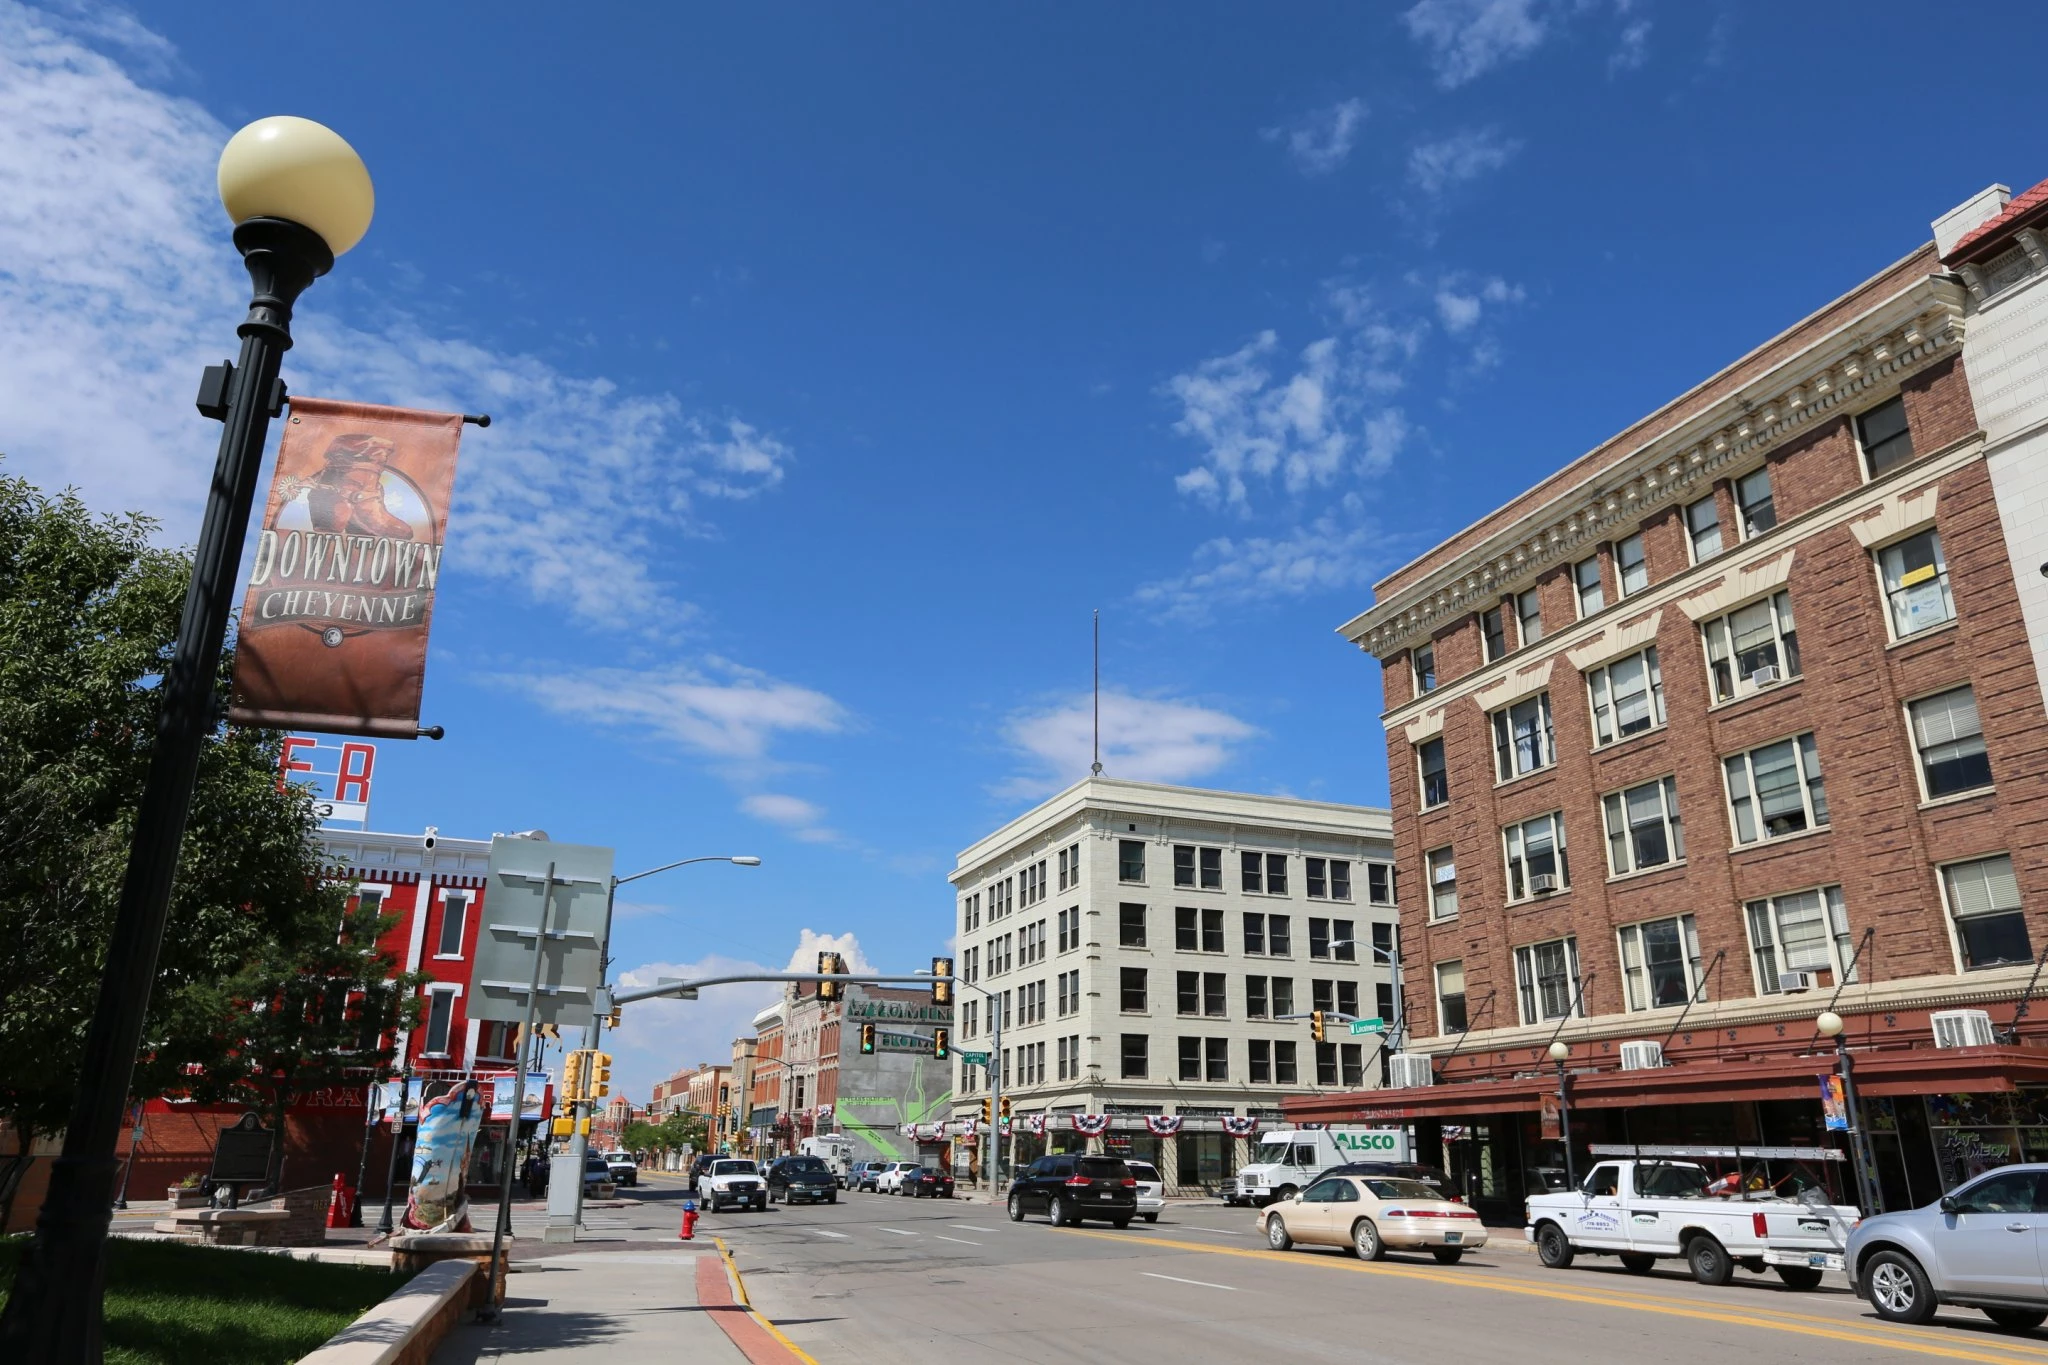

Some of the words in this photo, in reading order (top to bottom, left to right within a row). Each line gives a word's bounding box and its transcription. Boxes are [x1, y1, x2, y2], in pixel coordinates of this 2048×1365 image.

[249, 529, 443, 590] DOWNTOWN
[261, 590, 417, 623] CHEYENNE
[849, 1000, 954, 1020] WYOMIN
[1335, 1133, 1395, 1150] ALSCO
